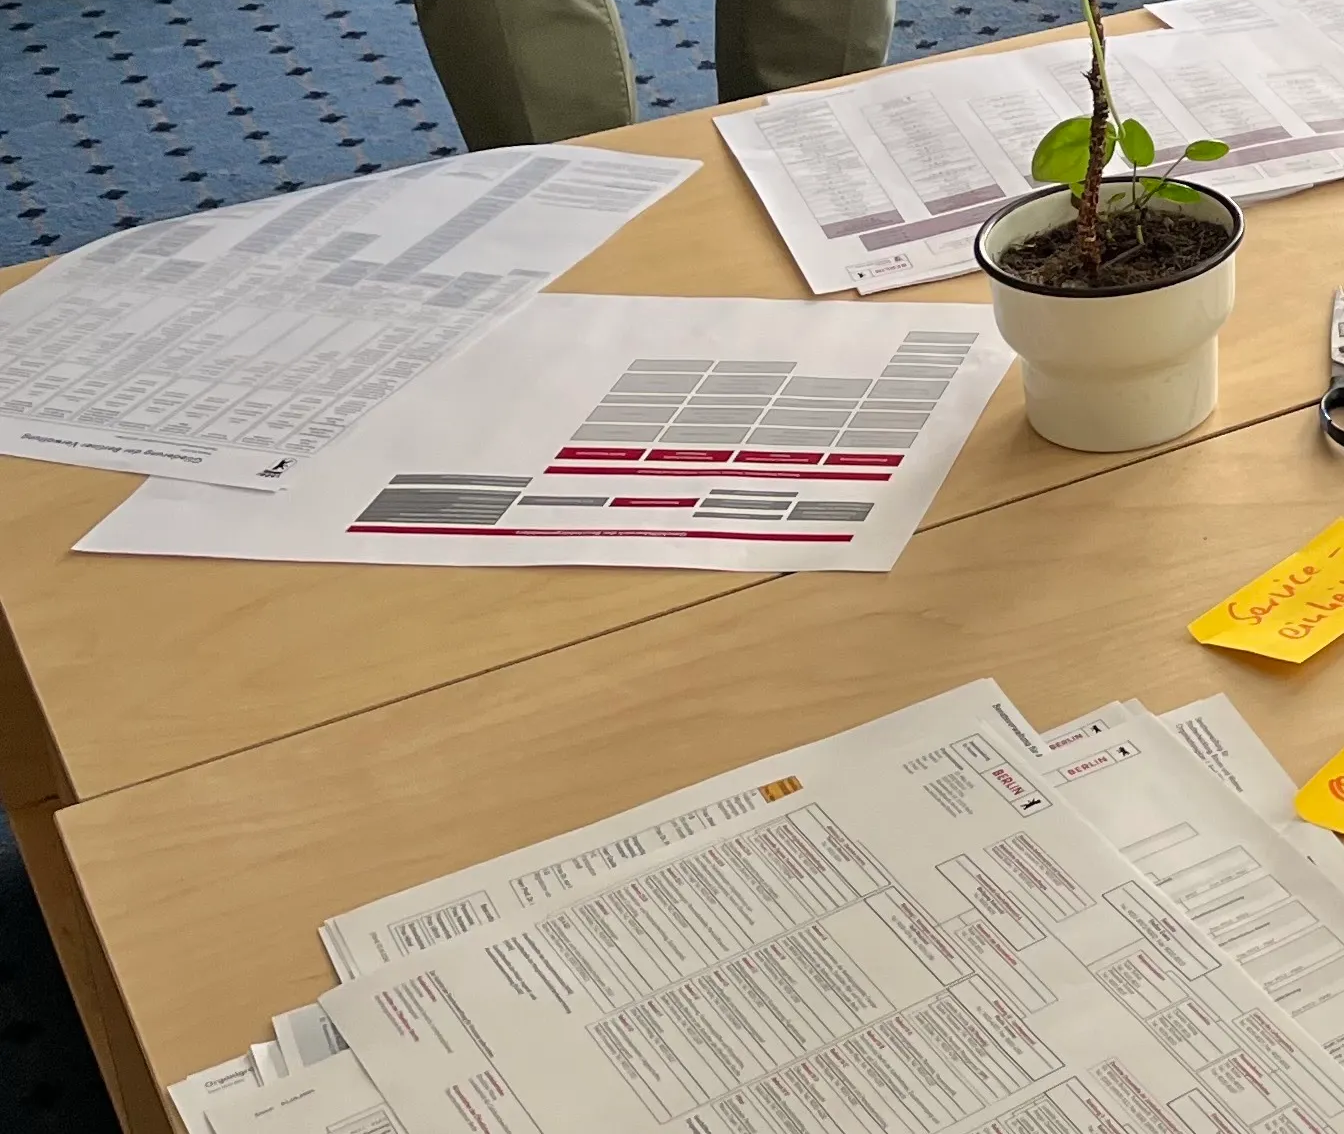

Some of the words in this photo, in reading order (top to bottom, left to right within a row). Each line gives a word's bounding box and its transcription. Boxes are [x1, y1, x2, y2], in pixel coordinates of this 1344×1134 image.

[1048, 733, 1083, 751] BERLIN
[1067, 756, 1108, 776] BERLIN
[991, 768, 1025, 796] BERLIN
